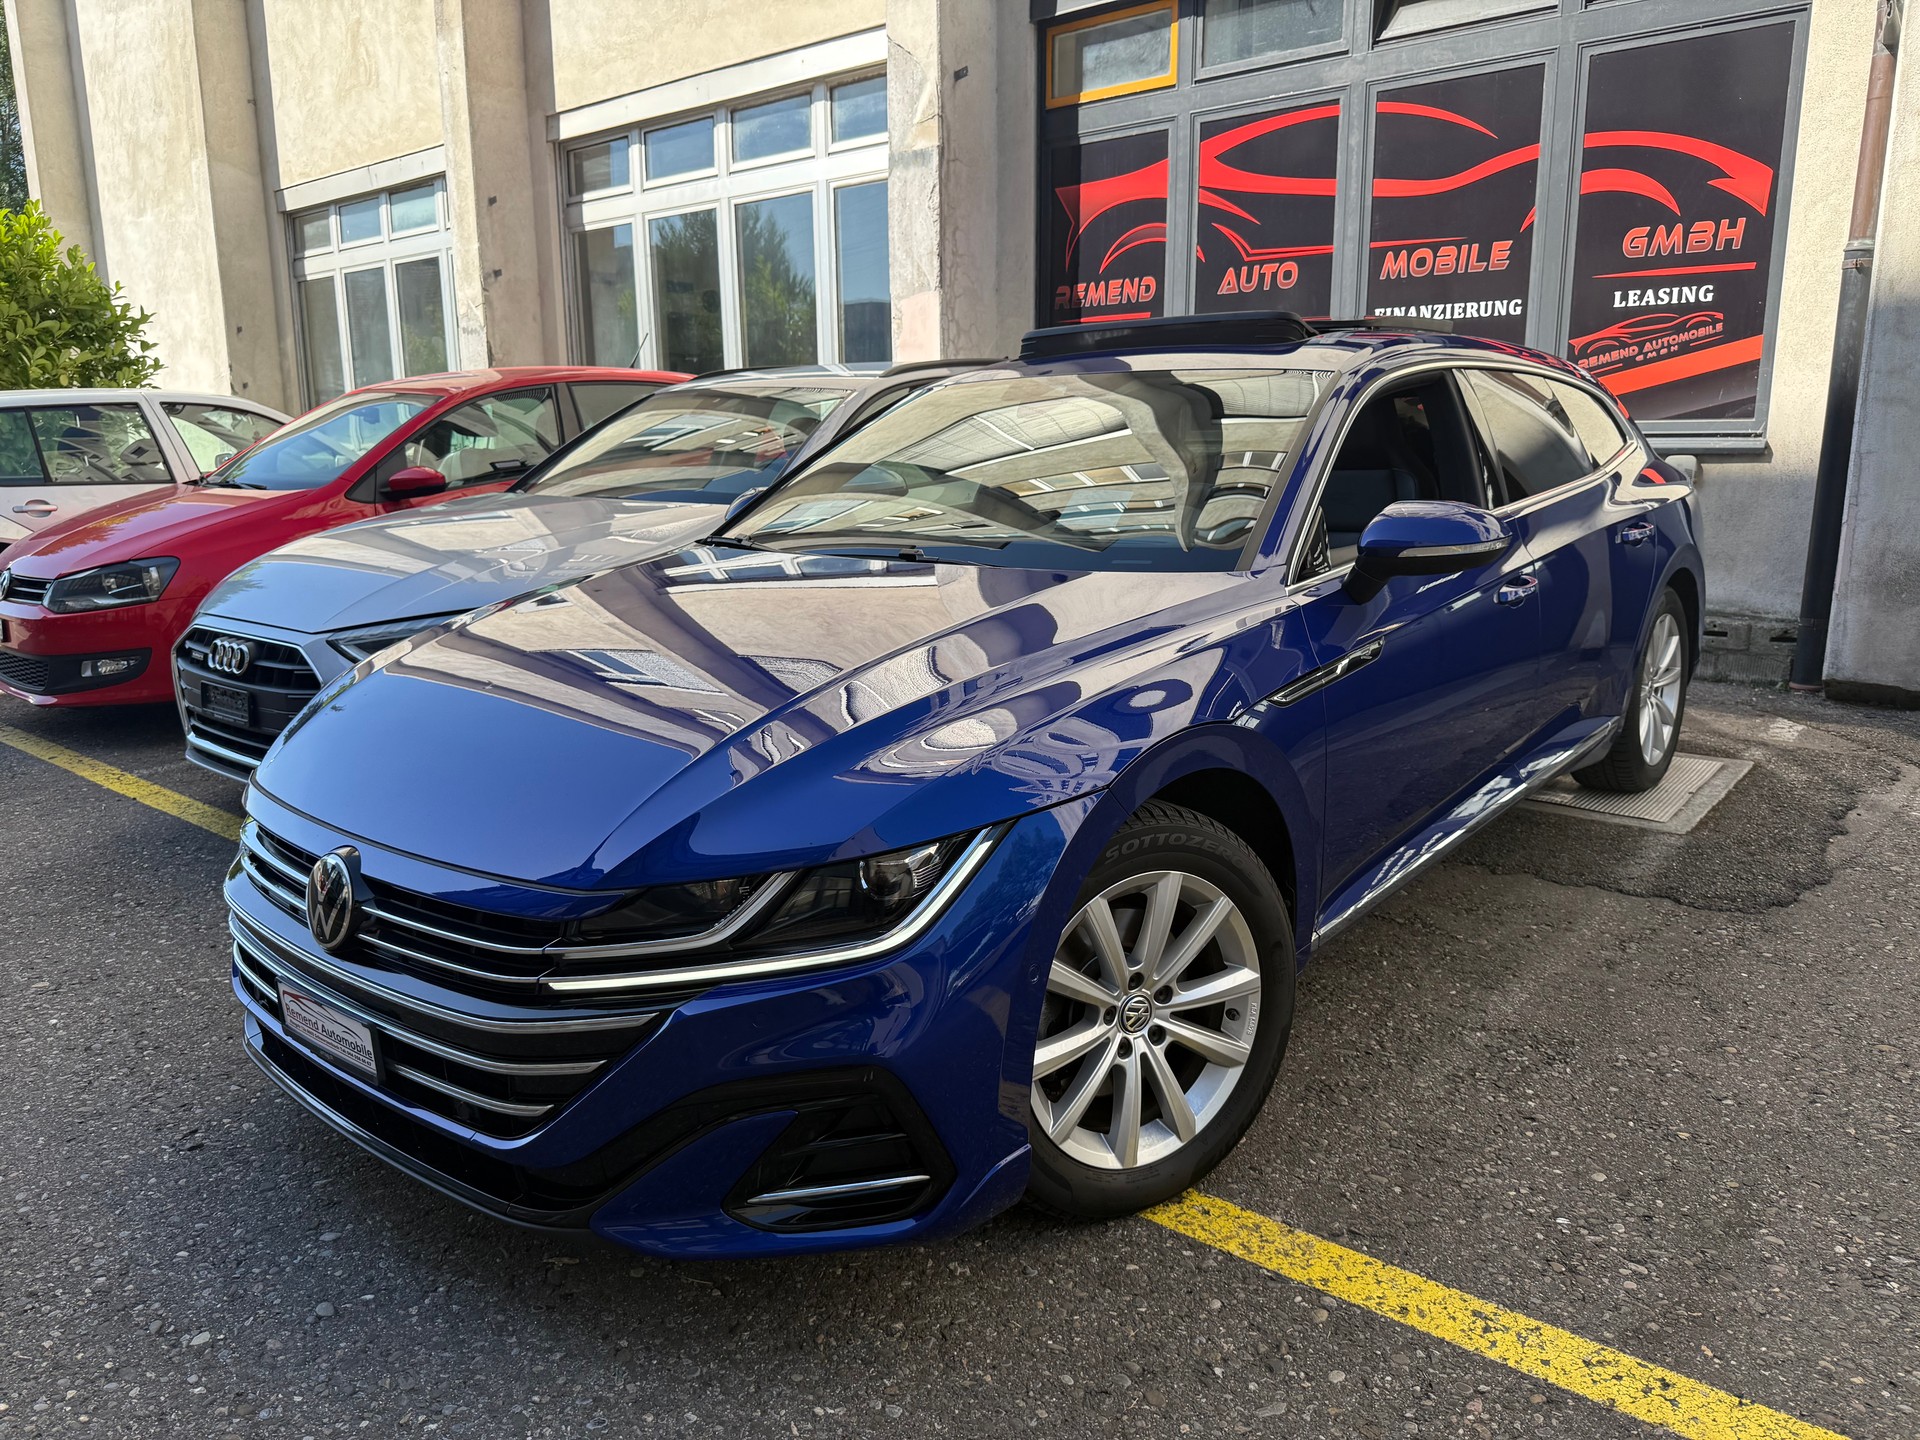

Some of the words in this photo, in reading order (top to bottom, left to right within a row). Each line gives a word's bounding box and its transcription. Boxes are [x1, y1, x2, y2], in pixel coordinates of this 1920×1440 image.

[1055, 276, 1157, 310] REMEND
[1217, 261, 1299, 295] AUTO
[1379, 240, 1513, 280] MOBILE
[1622, 217, 1747, 258] GMBH
[1612, 284, 1715, 308] LEASING
[1577, 345, 1639, 370] REMEND
[1642, 322, 1724, 353] AUTOMOBILE
[285, 1003, 319, 1031] Remend
[321, 1023, 373, 1058] Automobile
